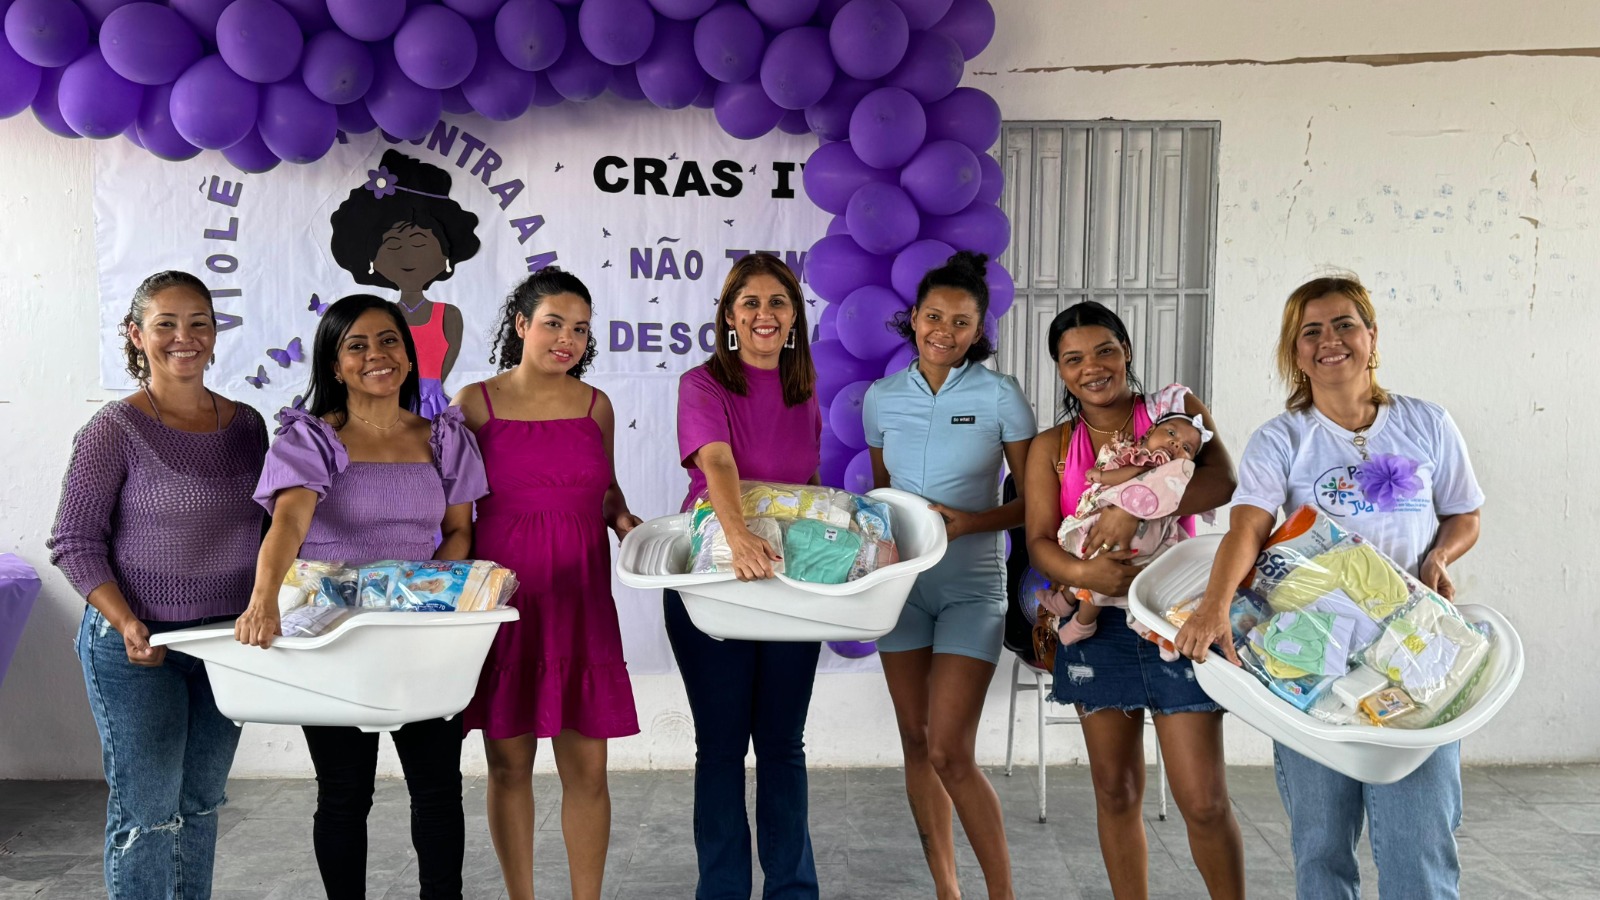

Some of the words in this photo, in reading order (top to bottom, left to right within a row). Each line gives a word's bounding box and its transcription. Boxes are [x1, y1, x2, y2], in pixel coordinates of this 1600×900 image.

[381, 119, 525, 211] NTRA
[509, 214, 546, 246] A
[593, 155, 743, 198] CRAS
[771, 161, 806, 199] I
[630, 236, 704, 281] NÃO
[609, 320, 717, 355] DESC
